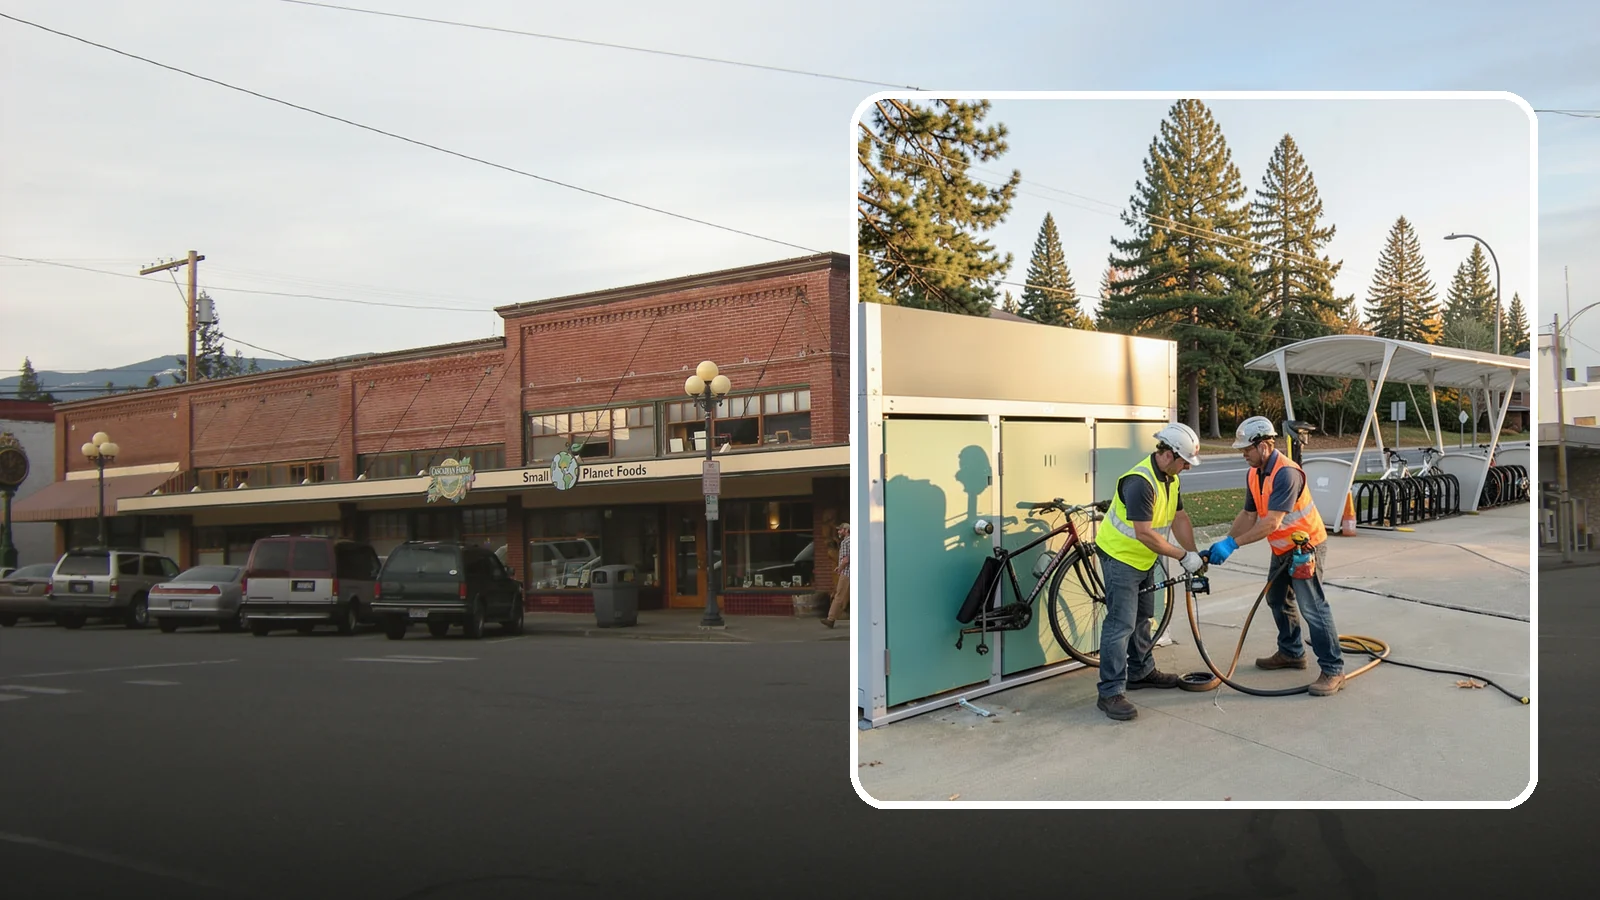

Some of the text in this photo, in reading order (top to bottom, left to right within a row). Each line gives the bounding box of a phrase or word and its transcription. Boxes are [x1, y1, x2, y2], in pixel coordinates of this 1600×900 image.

[523, 464, 647, 483] Small Planet Foods
